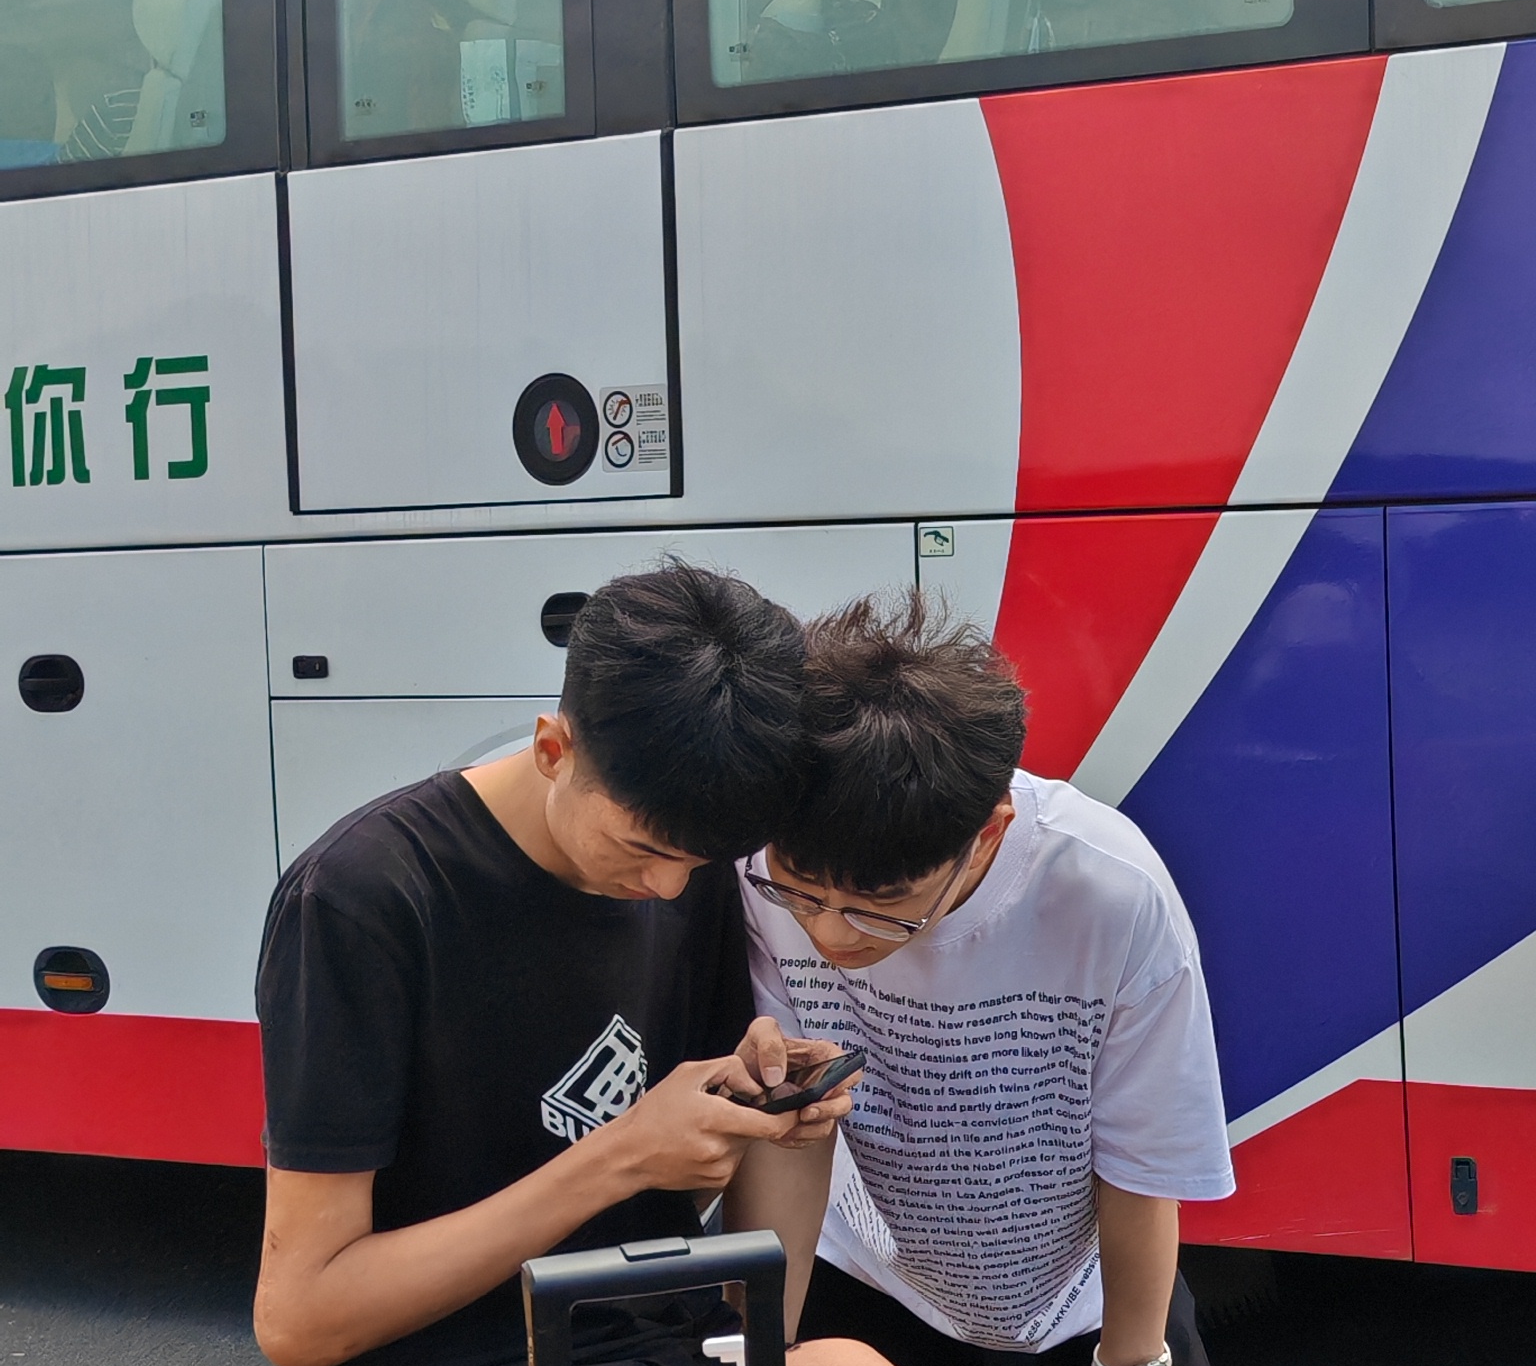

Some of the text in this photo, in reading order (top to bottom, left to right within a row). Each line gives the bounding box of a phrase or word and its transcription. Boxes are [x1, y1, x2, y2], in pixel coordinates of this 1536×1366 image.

[4, 354, 211, 487] 你行
[779, 957, 817, 969] people
[785, 975, 834, 992] feel they
[822, 1000, 840, 1010] are
[879, 990, 906, 1006] belief
[907, 998, 928, 1011] that
[931, 1002, 955, 1015] they
[958, 1003, 976, 1012] are
[979, 992, 1023, 1009] masters
[1026, 990, 1037, 1002] of
[1038, 992, 1062, 1005] their
[804, 1018, 829, 1030] their
[831, 1019, 862, 1036] ability
[898, 1014, 908, 1023] of
[909, 1015, 935, 1029] fate.
[938, 1019, 963, 1030] New
[966, 1011, 1018, 1029] research
[1020, 1009, 1054, 1023] shows
[888, 1028, 961, 1048] Psychologists
[964, 1032, 991, 1045] have
[994, 1030, 1018, 1041] long
[1020, 1028, 1056, 1041] known
[895, 1046, 916, 1060] their
[920, 1051, 968, 1063] destinies
[971, 1052, 989, 1062] are
[991, 1048, 1019, 1059] more
[1021, 1047, 1049, 1059] likely
[1051, 1045, 1061, 1054] to
[900, 1066, 921, 1078] that
[923, 1068, 947, 1082] they
[949, 1068, 972, 1080] drift
[975, 1069, 988, 1078] on
[991, 1065, 1009, 1075] the
[1011, 1062, 1056, 1076] currents
[1058, 1059, 1069, 1068] of
[934, 1075, 1088, 1096] of Swedish twins report that
[936, 1103, 957, 1113] and
[959, 1102, 991, 1113] partly
[994, 1101, 1029, 1112] drawn
[1031, 1092, 1055, 1105] from
[863, 1102, 893, 1117] belief
[971, 1114, 1029, 1128] conviction
[1032, 1107, 1053, 1118] that
[852, 1120, 905, 1143] something
[951, 1134, 960, 1143] in
[963, 1133, 980, 1143] life
[983, 1132, 1003, 1143] and
[1006, 1129, 1025, 1139] has
[1028, 1122, 1068, 1134] nothing
[1070, 1126, 1081, 1135] to
[878, 1144, 935, 1158] conducted
[939, 1149, 950, 1158] at
[954, 1148, 971, 1157] the
[974, 1140, 1034, 1158] Karolinska
[907, 1162, 948, 1171] awards
[951, 1162, 970, 1171] the
[973, 1161, 1006, 1172] Nobel
[1009, 1156, 1037, 1167] Prize
[1040, 1153, 1055, 1162] for
[892, 1174, 911, 1183] and
[913, 1176, 961, 1186] Margaret
[1003, 1168, 1054, 1184] professor
[1056, 1167, 1067, 1176] of
[942, 1189, 952, 1198] in
[957, 1190, 976, 1199] Los
[1029, 1183, 1057, 1192] Their
[898, 1199, 933, 1210] States
[935, 1202, 944, 1211] in
[947, 1202, 965, 1211] the
[967, 1202, 1008, 1212] Journal
[1010, 1198, 1022, 1207] of
[903, 1212, 914, 1220] to
[917, 1214, 954, 1223] control
[957, 1216, 981, 1224] their
[984, 1215, 1008, 1224] lives
[1011, 1211, 1038, 1220] have
[943, 1227, 974, 1237] being
[1001, 1220, 1048, 1233] adjusted
[981, 1236, 1031, 1248] believing
